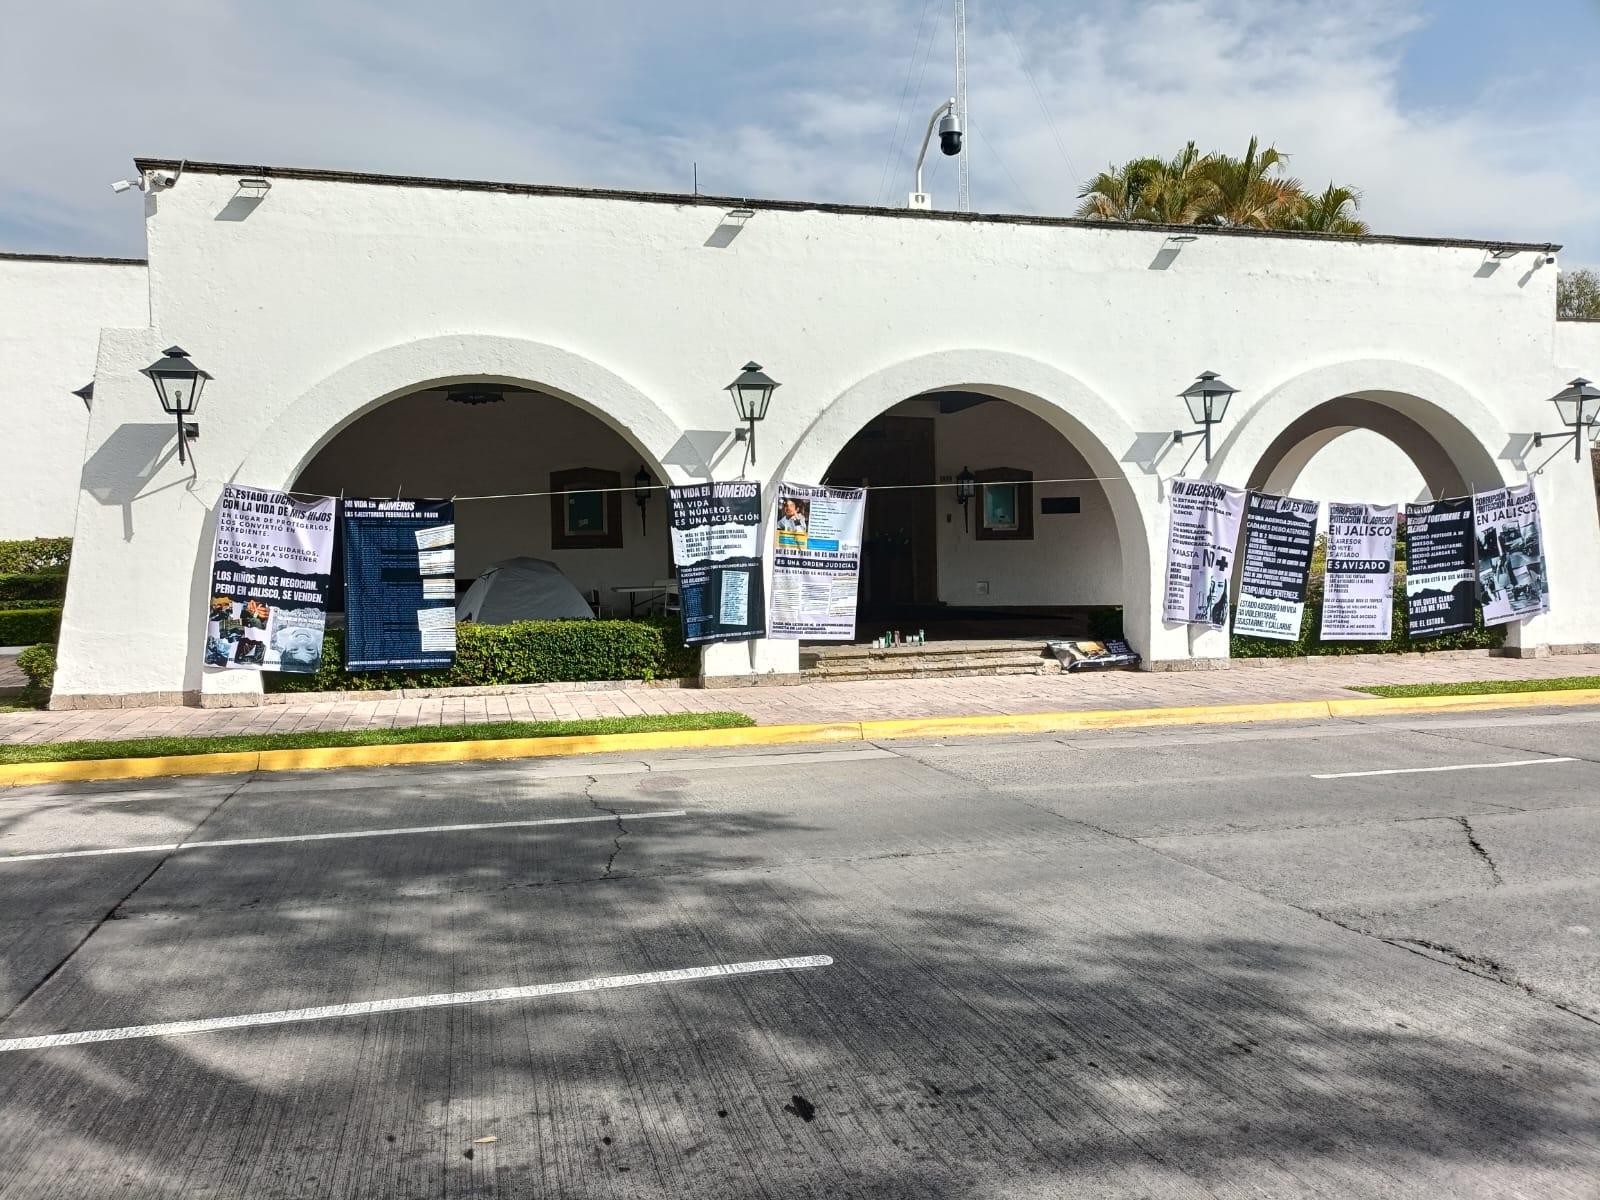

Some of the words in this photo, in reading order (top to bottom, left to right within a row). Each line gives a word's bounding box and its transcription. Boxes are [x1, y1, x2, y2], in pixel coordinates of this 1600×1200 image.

[224, 488, 233, 498] EL
[236, 489, 268, 502] ESTADO
[670, 489, 681, 499] MI
[683, 488, 700, 498] VIDA
[702, 486, 710, 496] EN
[712, 483, 757, 498] NÚMEROS
[1172, 482, 1186, 494] MI
[1186, 483, 1226, 500] DECISIÓN
[222, 499, 239, 510] CON
[242, 502, 252, 511] LA
[255, 504, 275, 514] VIDA
[278, 506, 288, 516] DE
[289, 508, 306, 520] MIS
[307, 511, 332, 522] HIJOS
[689, 506, 730, 516] NÚMEROS
[1292, 503, 1300, 511] ES
[711, 512, 759, 522] ACUSACIÓN
[1477, 514, 1489, 526] EN
[1492, 502, 1537, 522] JALISCO
[221, 526, 270, 537] EXPEDIENTE.
[1329, 525, 1340, 535] EN
[1344, 526, 1392, 536] JALISCO
[232, 541, 258, 549] LUGAR
[280, 553, 317, 563] SOSTENER
[1342, 561, 1385, 570] AVISADO
[217, 571, 232, 581] LOS
[233, 571, 255, 584] NIÑOS
[257, 576, 267, 585] NO
[269, 577, 278, 586] SE
[280, 578, 318, 591] NEGOCIAN.
[215, 583, 235, 594] PERO
[237, 586, 247, 595] EN
[248, 587, 280, 600] JALISCO,
[282, 590, 292, 600] SE
[293, 592, 324, 604] VENDEN.
[1415, 605, 1427, 613] ALGO
